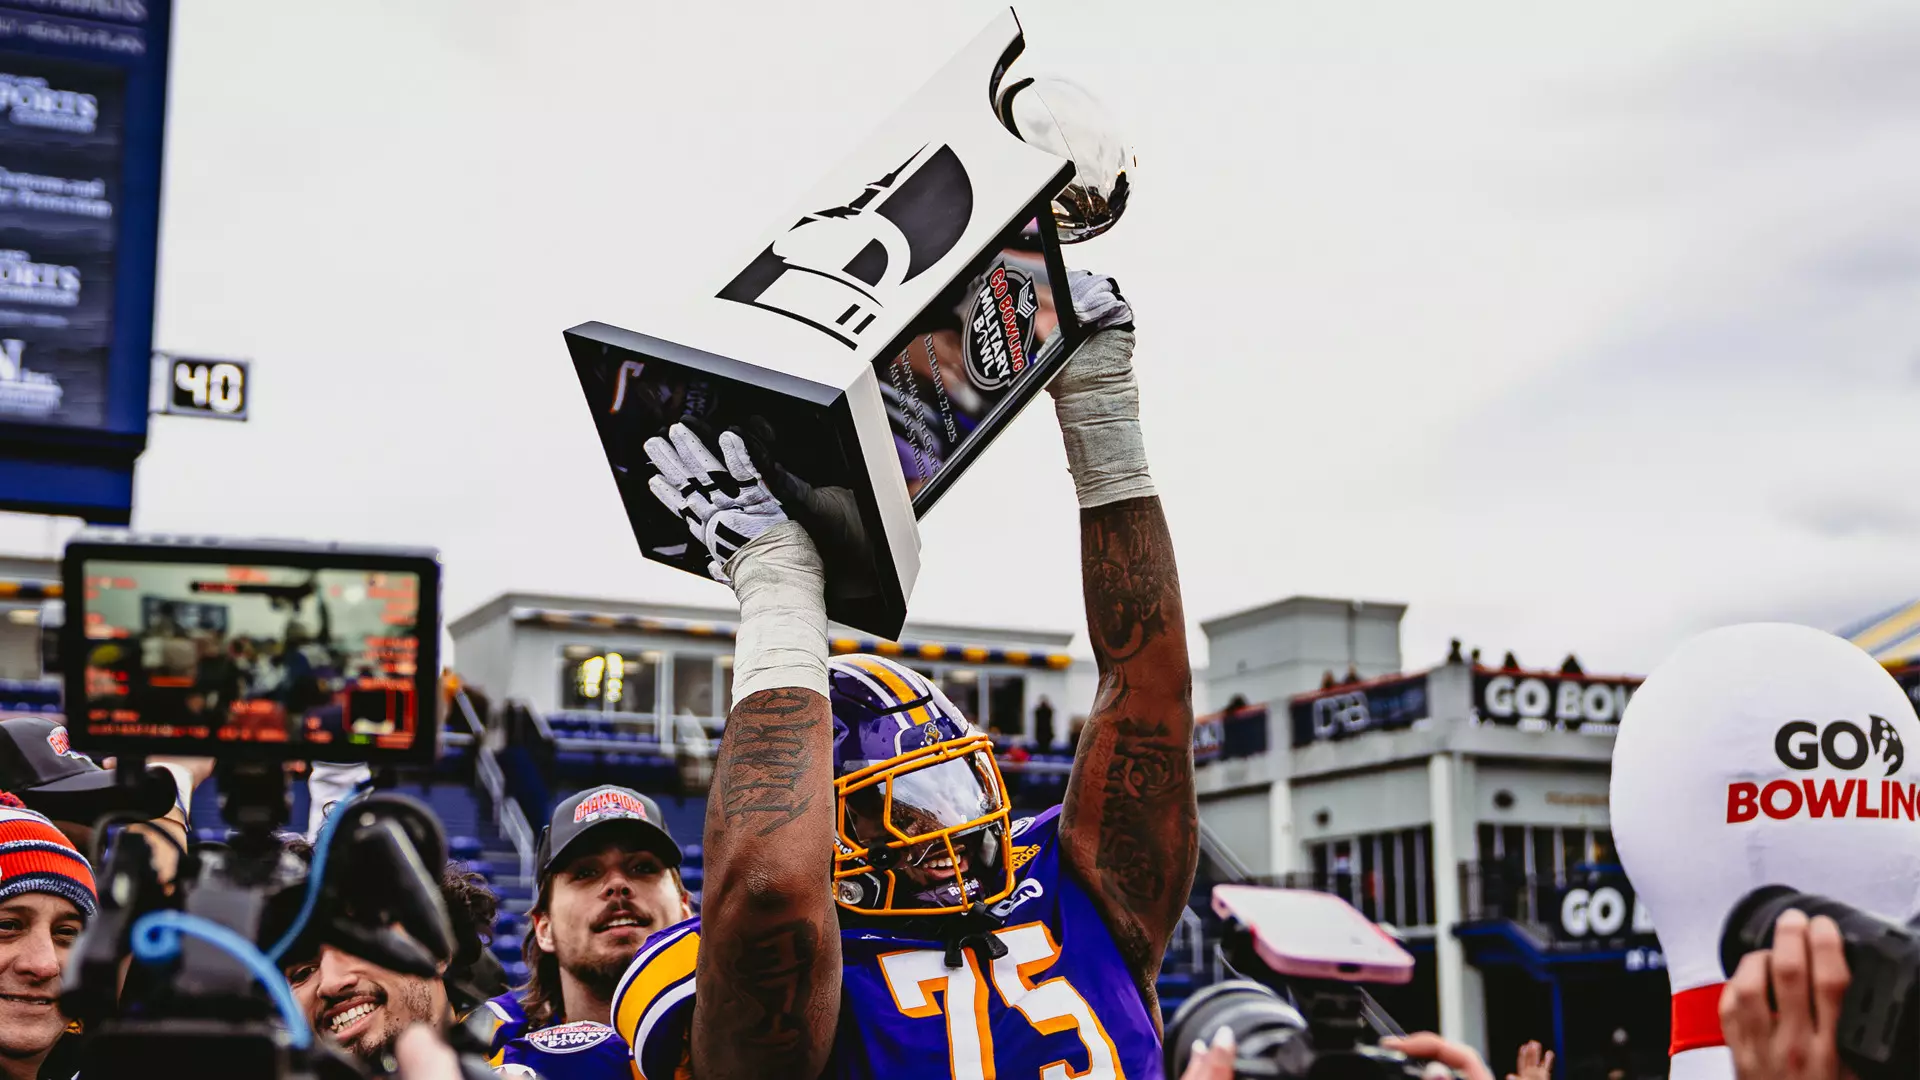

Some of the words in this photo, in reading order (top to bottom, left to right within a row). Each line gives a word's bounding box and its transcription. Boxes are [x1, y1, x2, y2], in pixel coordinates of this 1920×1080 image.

[990, 267, 1009, 299] GO
[980, 286, 1010, 380] MILITARY
[999, 295, 1025, 373] BOWLING
[175, 363, 243, 413] 40
[944, 414, 958, 443] 2025
[907, 427, 928, 483] STADIUM
[1485, 675, 1550, 717] GO
[1775, 719, 1869, 770] GO
[1727, 778, 1920, 824] BOWLIN
[1561, 887, 1626, 936] GO
[876, 920, 1127, 1080] 75
